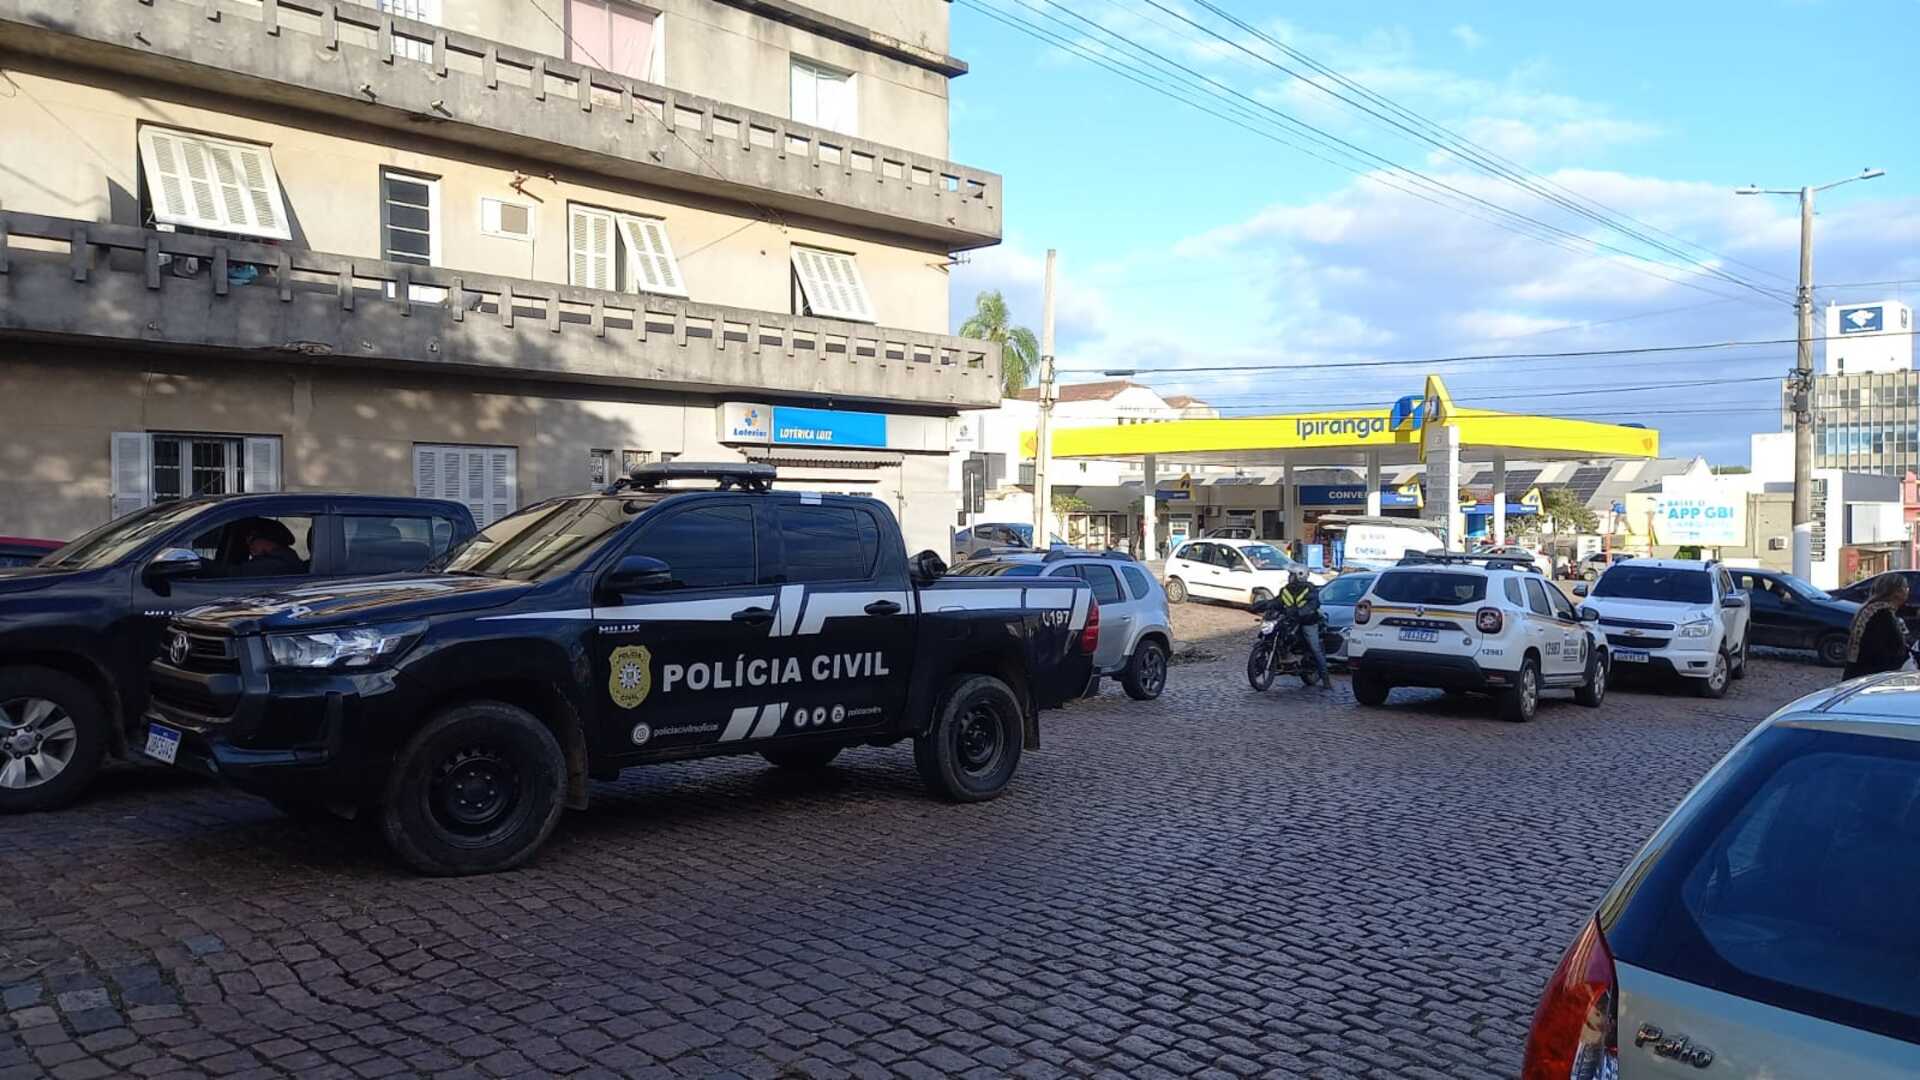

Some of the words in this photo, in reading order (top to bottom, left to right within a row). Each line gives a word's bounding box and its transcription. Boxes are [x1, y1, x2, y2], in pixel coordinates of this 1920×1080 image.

[779, 425, 814, 440] LOTÉRICA
[1296, 417, 1384, 440] Ipiranga
[1668, 507, 1700, 519] APP
[1704, 506, 1733, 519] GBI
[1049, 610, 1070, 625] 197
[663, 654, 802, 692] POLÍCIA
[812, 652, 889, 680] CIVIL
